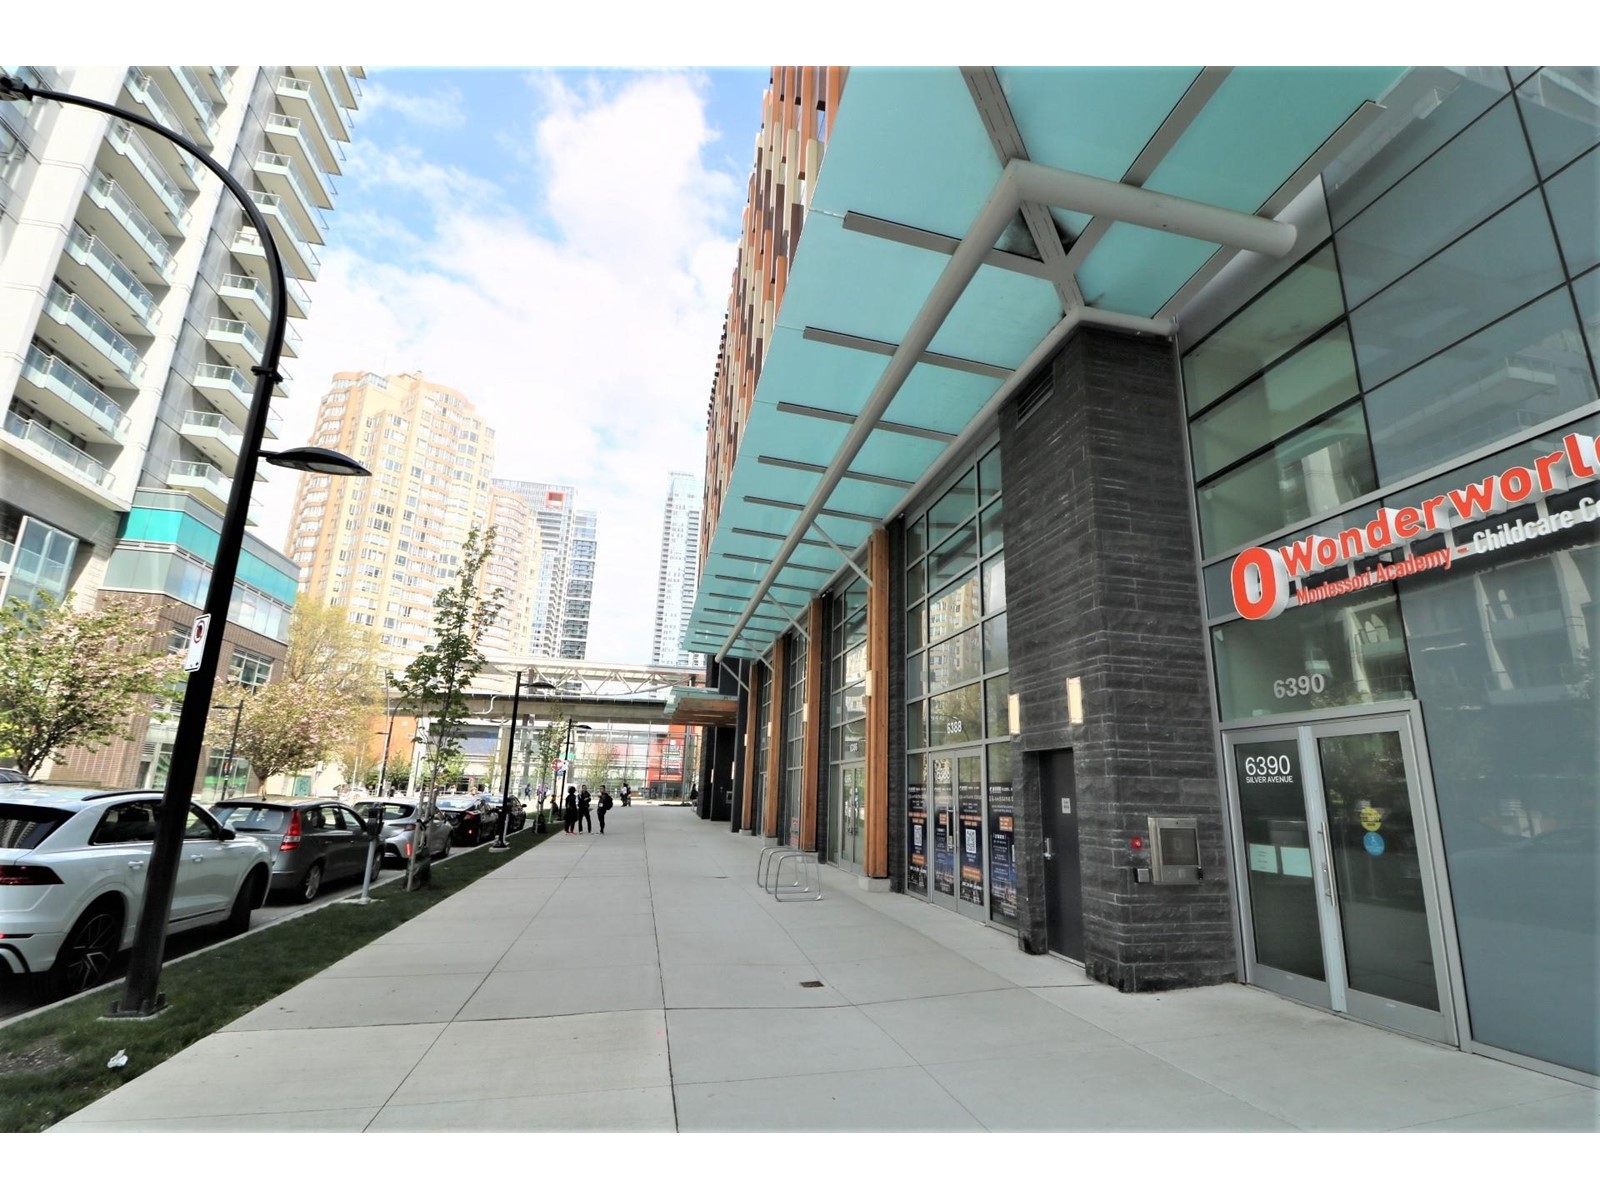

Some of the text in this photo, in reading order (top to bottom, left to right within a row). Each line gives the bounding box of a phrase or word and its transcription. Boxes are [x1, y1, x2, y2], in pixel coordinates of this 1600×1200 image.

[1279, 432, 1600, 577] Wonderworl
[1296, 566, 1373, 605] Montessori
[1376, 545, 1452, 583] Academy
[1473, 510, 1575, 554] Childcare
[1273, 673, 1325, 699] 6390
[947, 720, 962, 734] 6388
[1245, 755, 1290, 776] 6390
[1246, 775, 1293, 784] SILVER AVENUE
